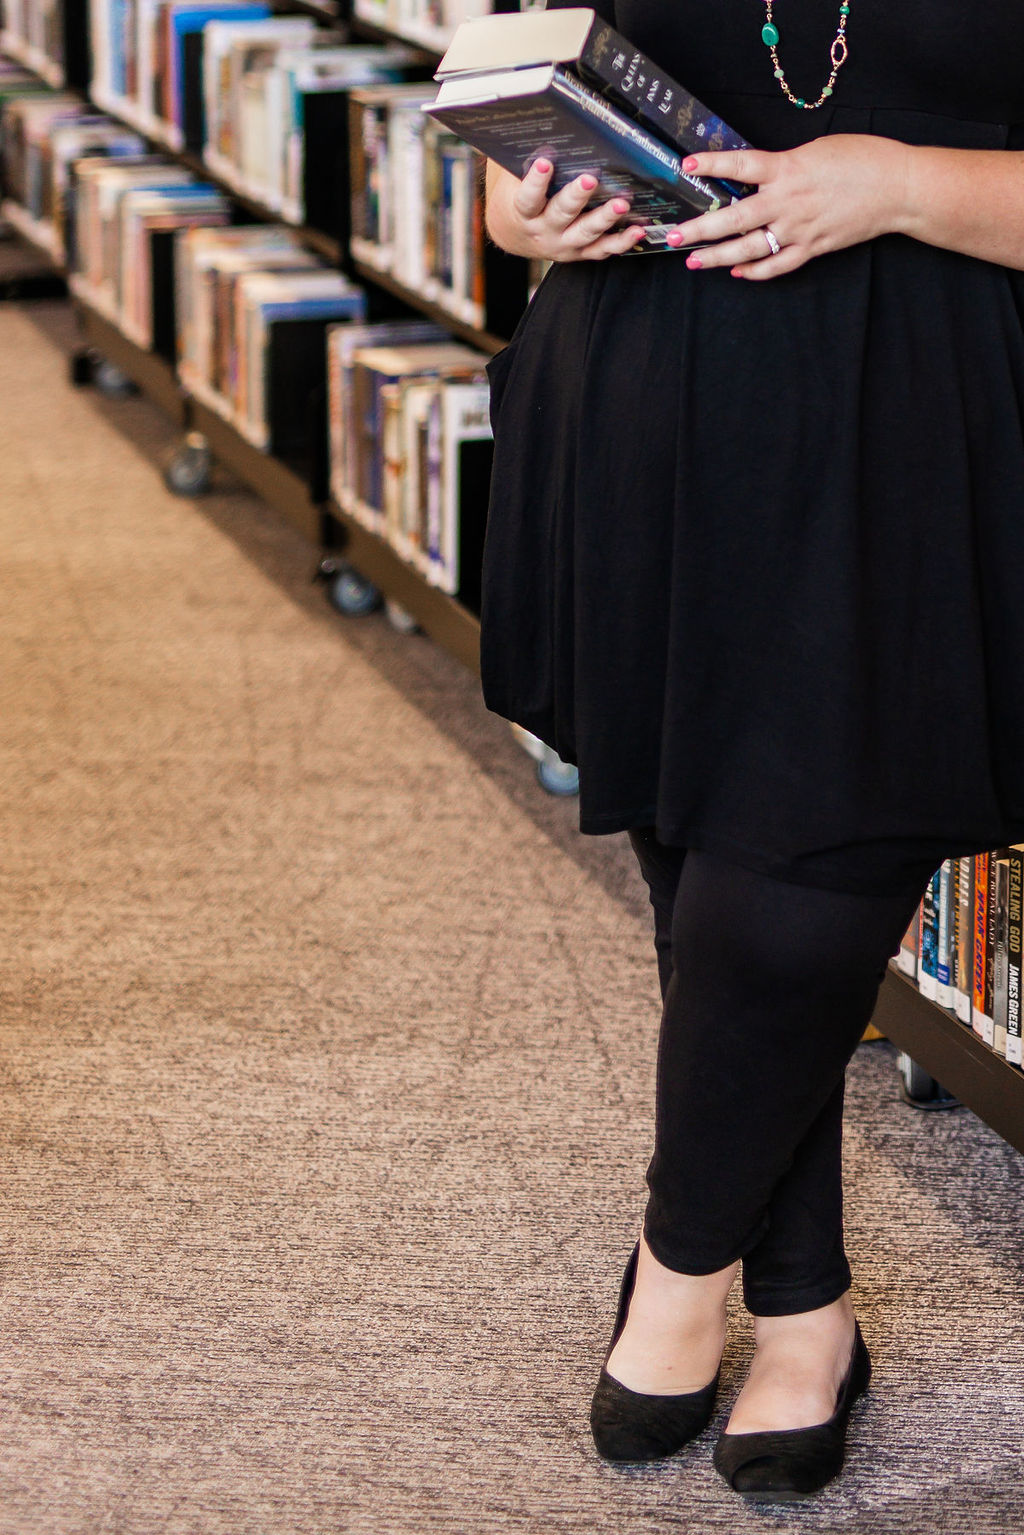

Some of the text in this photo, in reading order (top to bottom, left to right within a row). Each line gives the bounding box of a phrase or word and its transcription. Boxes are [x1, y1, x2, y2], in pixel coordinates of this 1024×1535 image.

[1008, 858, 1021, 1036] STEALING GOD JAMES GREEN
